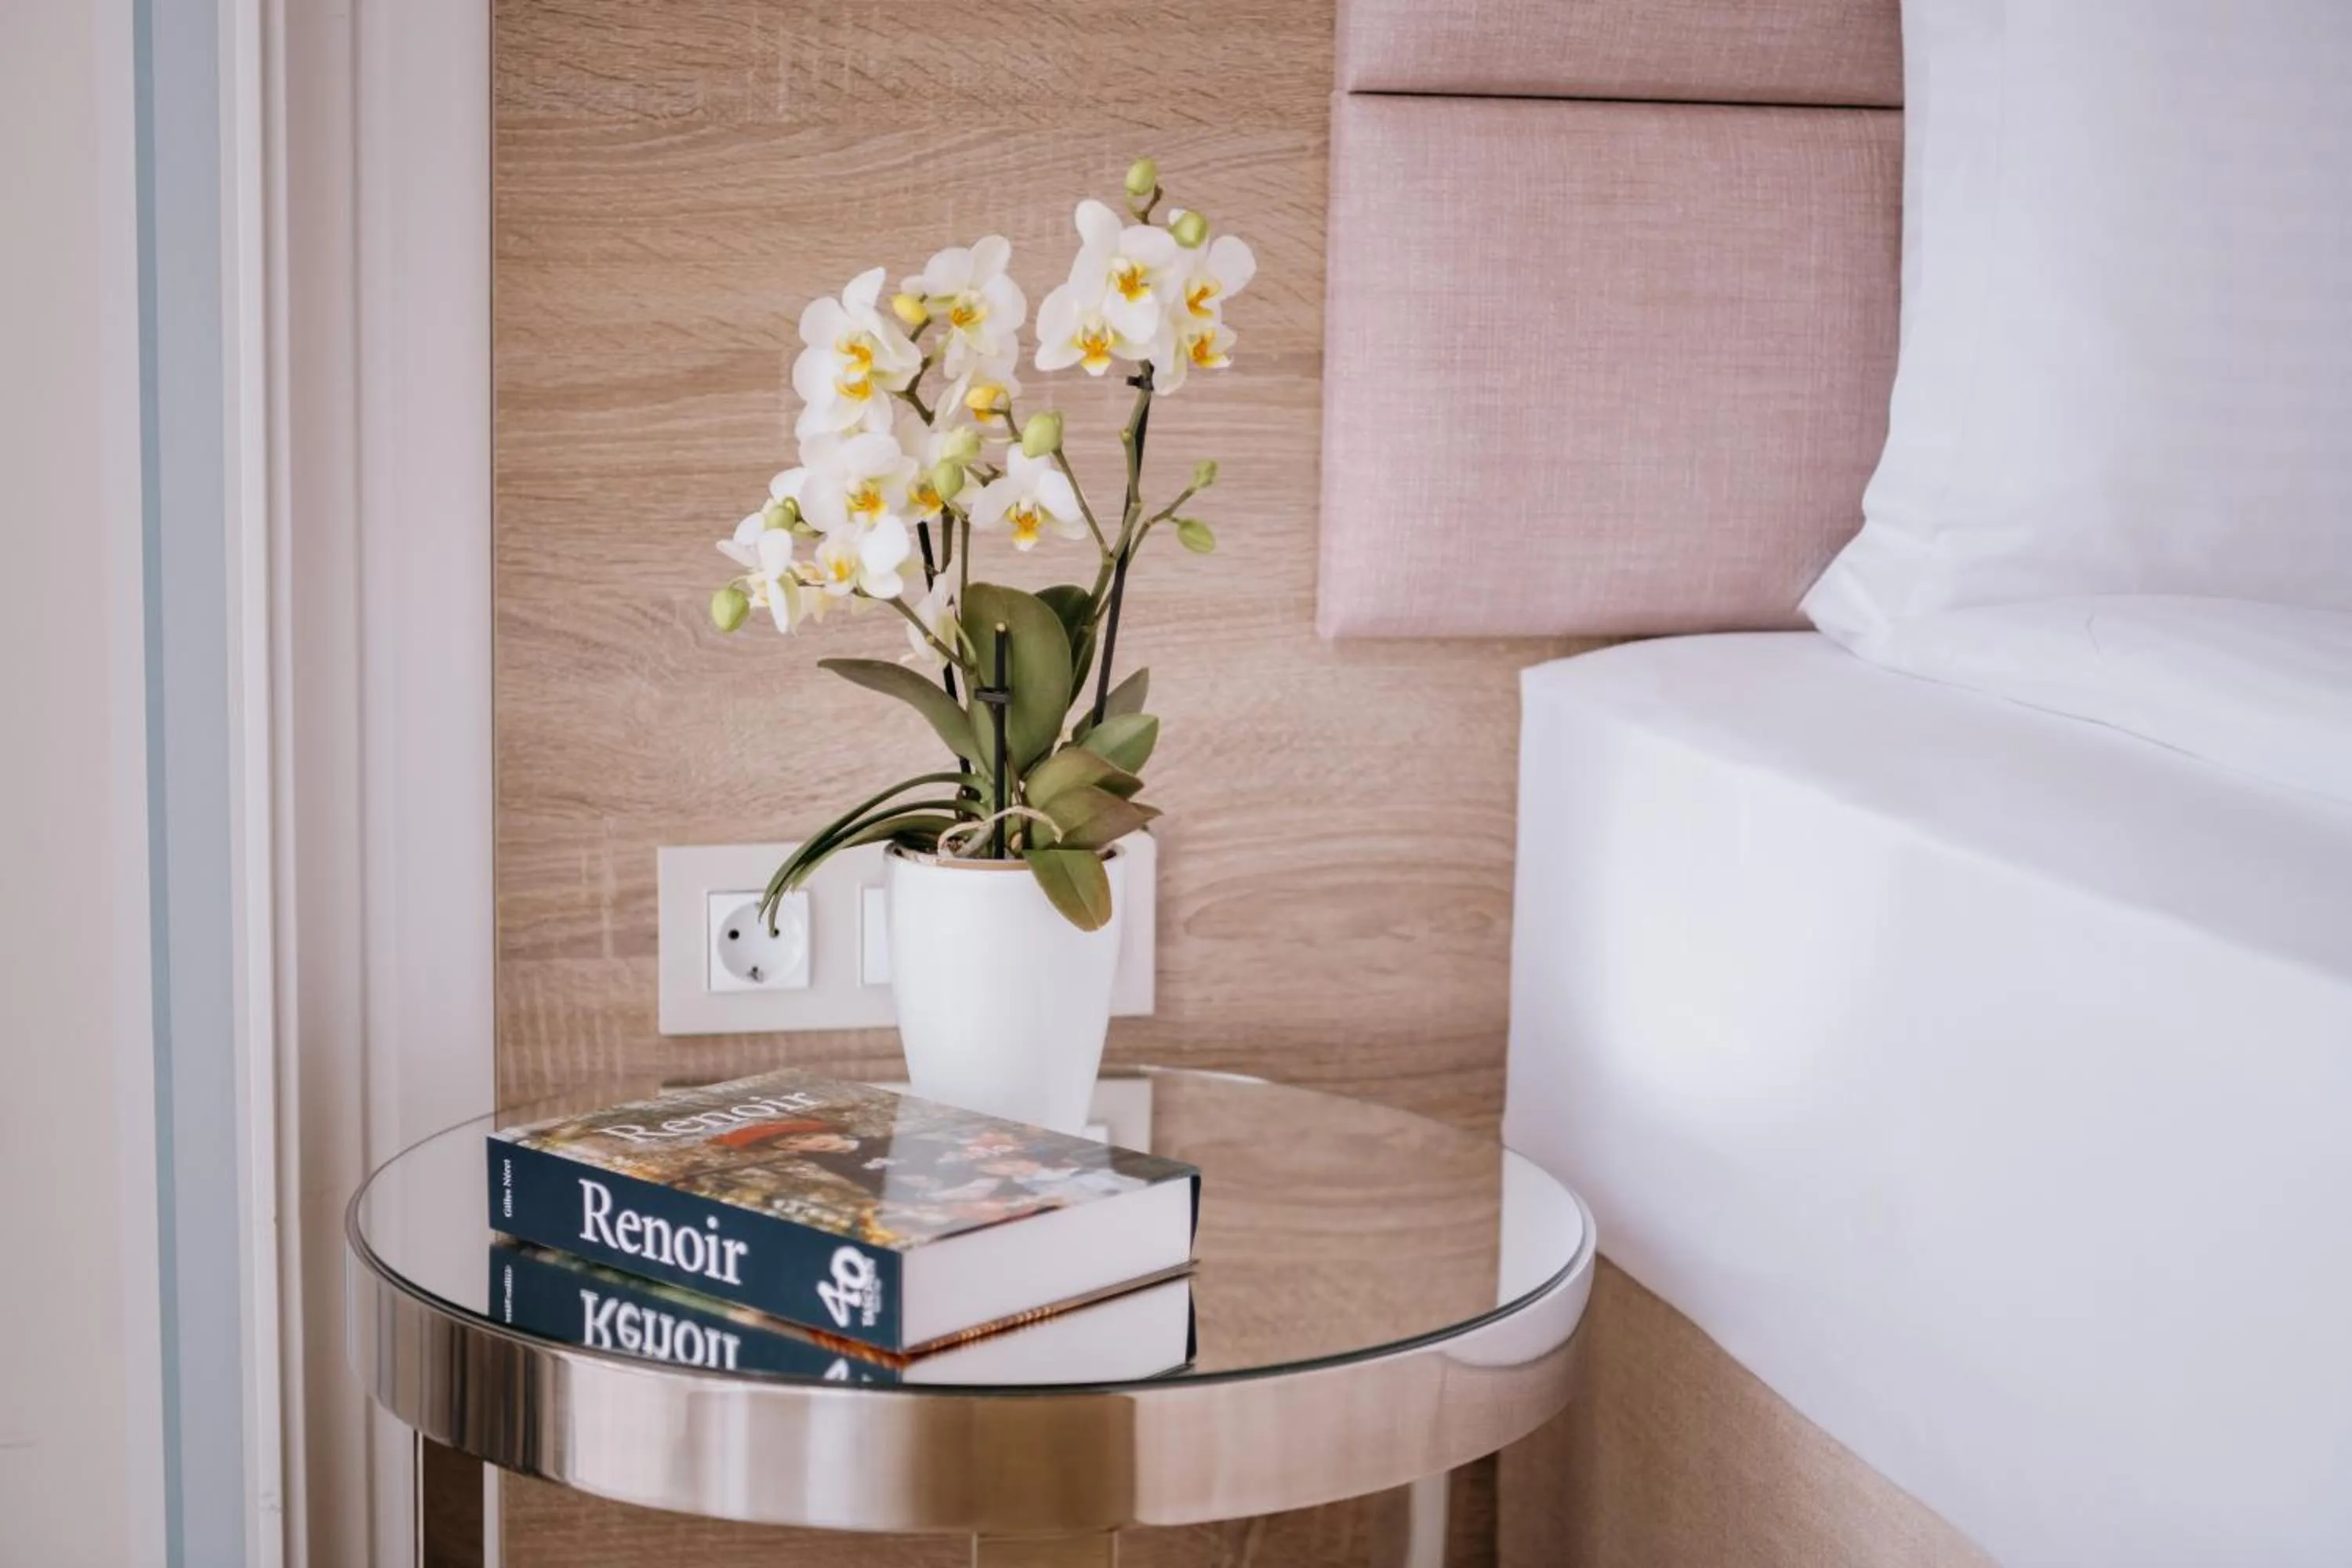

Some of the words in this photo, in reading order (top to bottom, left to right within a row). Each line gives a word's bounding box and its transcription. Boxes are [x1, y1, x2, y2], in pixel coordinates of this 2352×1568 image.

[593, 1092, 818, 1142] Renoir
[578, 1178, 749, 1285] Renoir
[817, 1245, 868, 1327] 40
